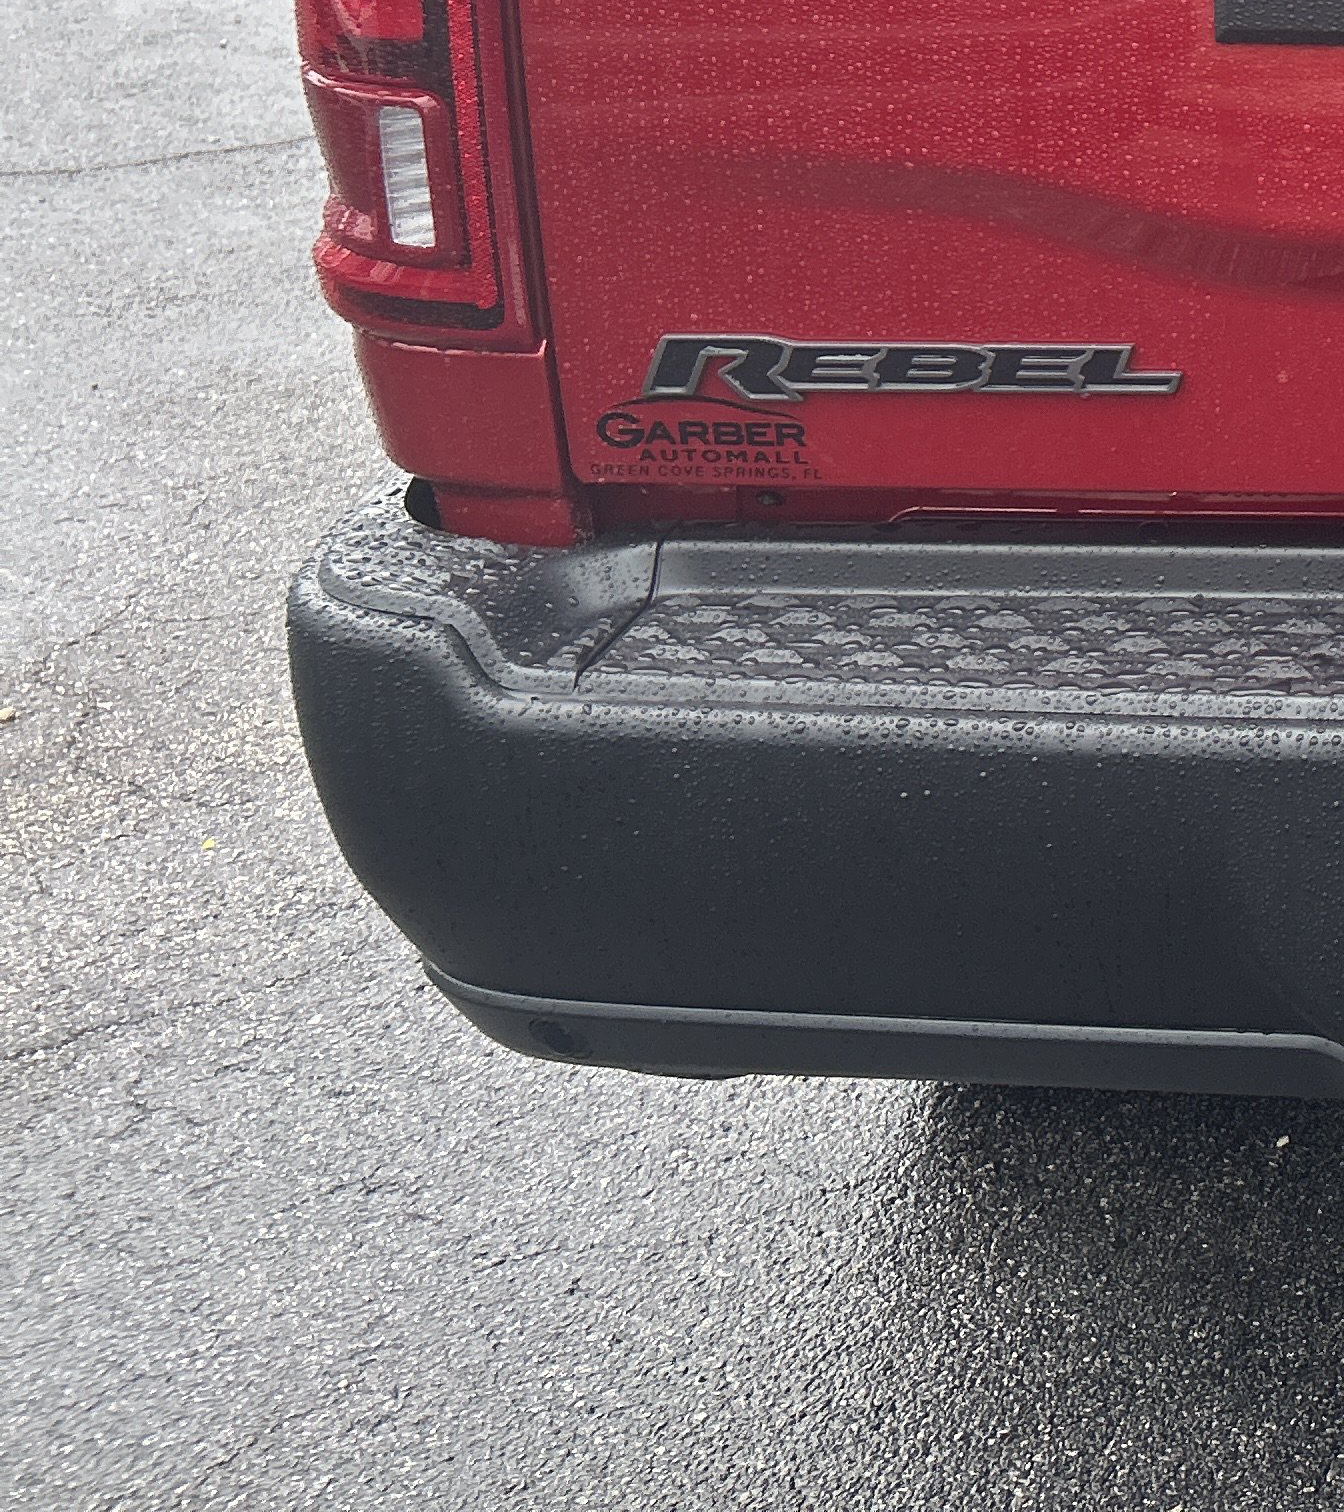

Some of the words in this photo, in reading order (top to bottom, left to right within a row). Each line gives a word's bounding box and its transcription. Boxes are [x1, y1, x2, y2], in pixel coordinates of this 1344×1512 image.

[640, 333, 1184, 402] REBEL
[596, 411, 807, 449] GARBER
[639, 448, 809, 465] AUTOMALL
[590, 463, 650, 477] GREEN
[657, 464, 705, 478] COVE
[712, 465, 798, 481] SPRINGS,
[803, 468, 823, 480] FL
